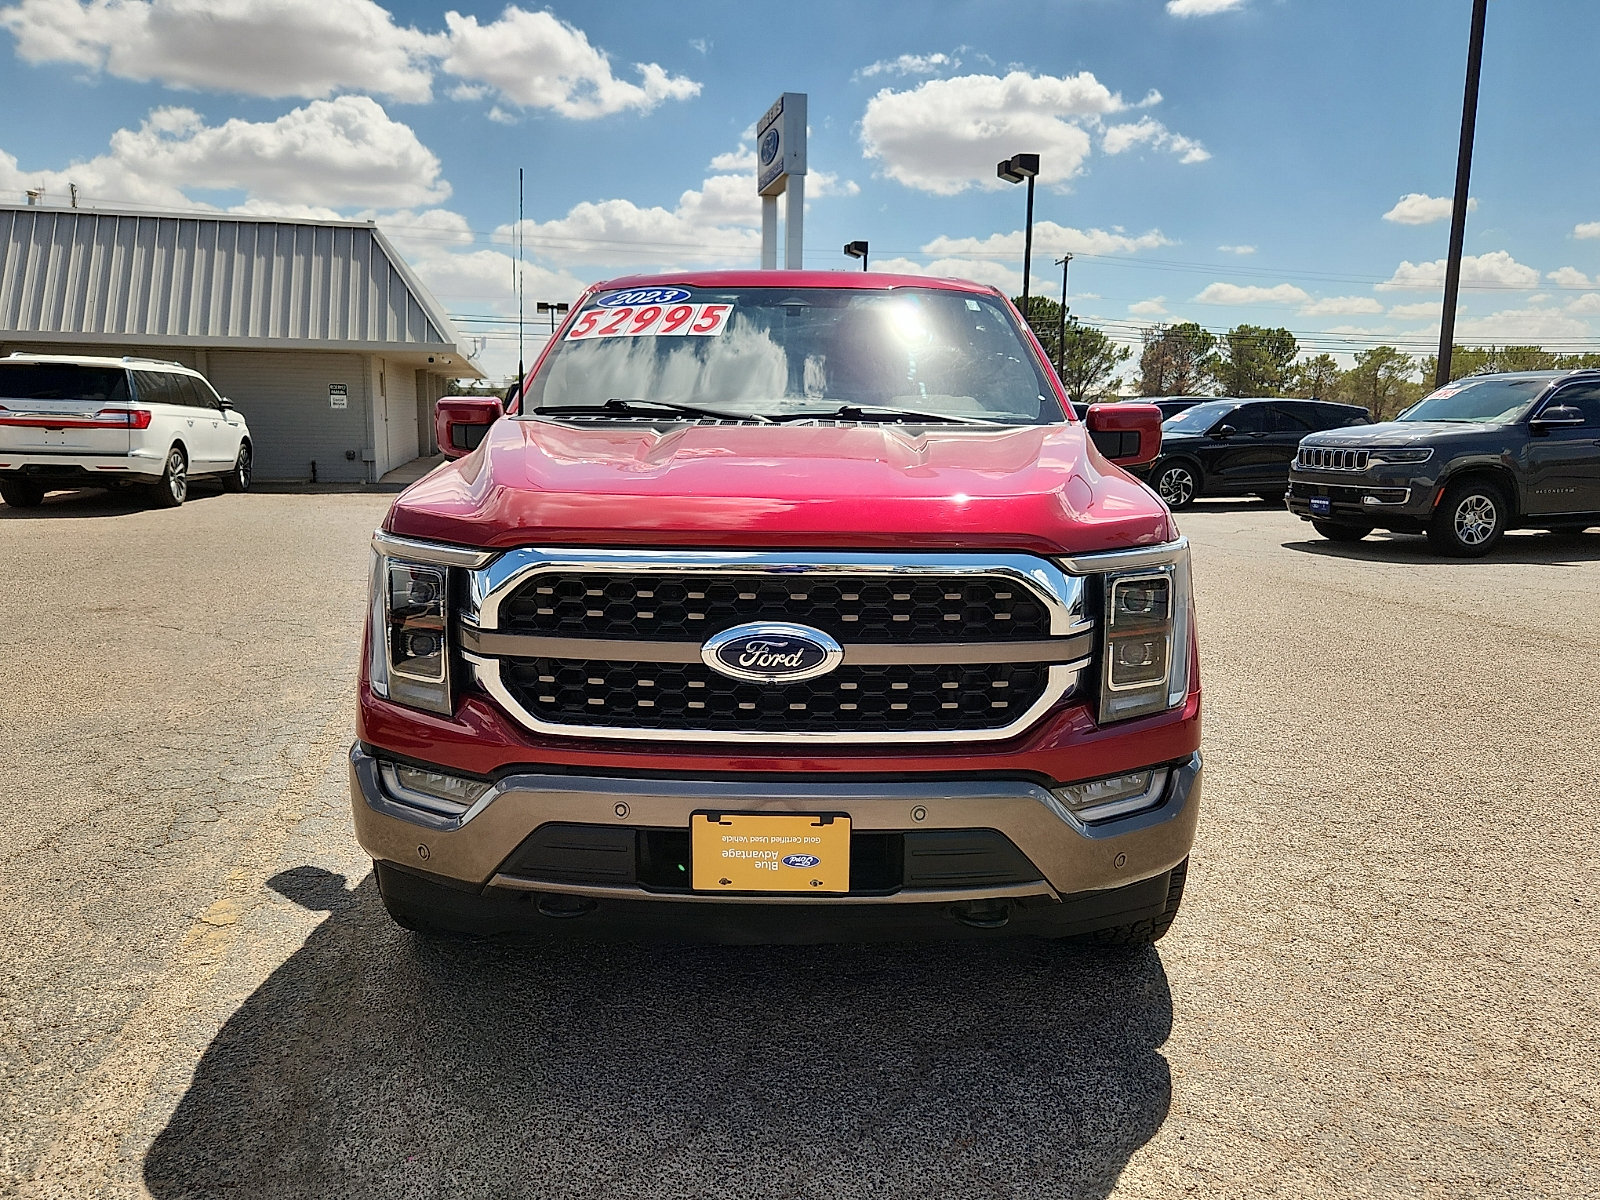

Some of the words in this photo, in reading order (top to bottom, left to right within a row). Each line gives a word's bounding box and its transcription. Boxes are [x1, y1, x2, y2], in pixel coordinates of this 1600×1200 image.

[608, 291, 679, 306] 2023
[570, 305, 729, 338] 52995
[738, 640, 805, 667] Ford
[721, 835, 749, 843] Vehicle
[770, 836, 802, 844] Certified
[803, 836, 821, 844] Gold
[721, 848, 779, 860] Advantage
[754, 860, 779, 871] Blue
[788, 855, 814, 867] Ford
